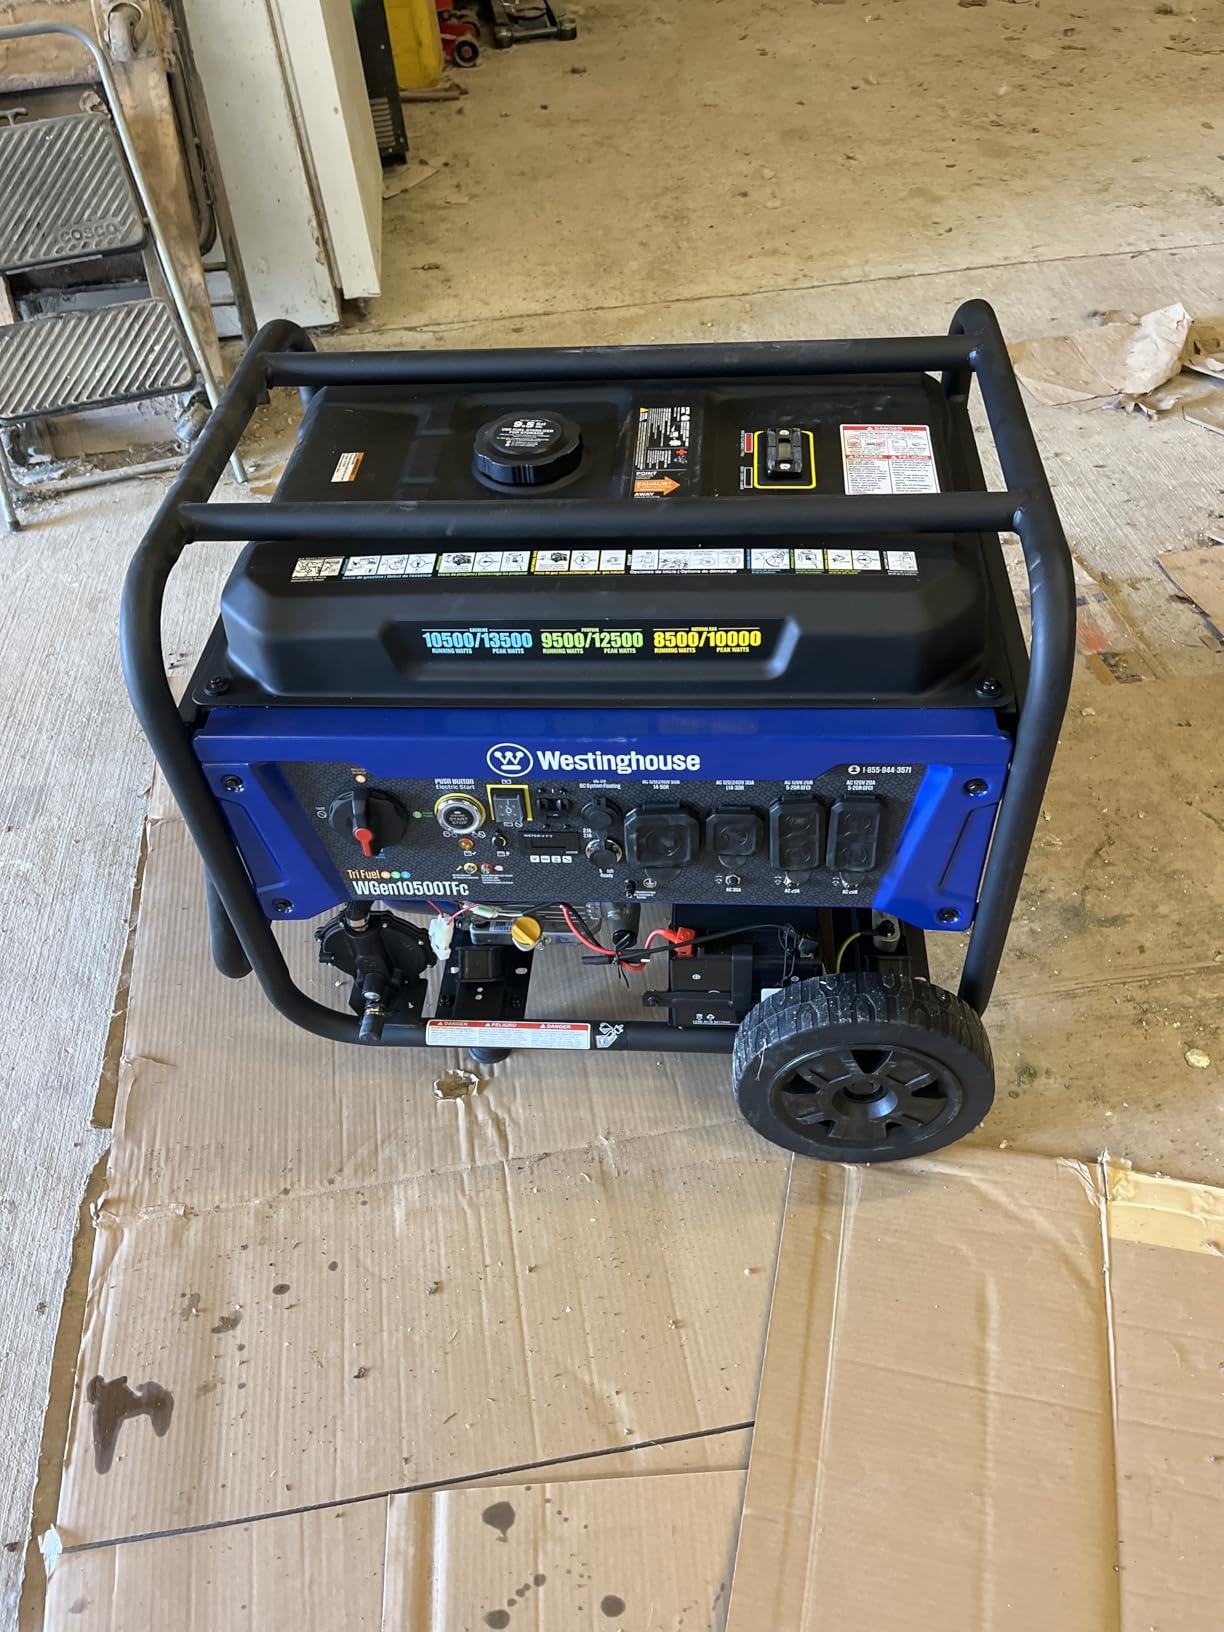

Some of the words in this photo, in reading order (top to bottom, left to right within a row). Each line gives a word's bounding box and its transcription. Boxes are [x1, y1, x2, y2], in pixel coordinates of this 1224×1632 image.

[61, 223, 119, 241] COSCO
[422, 632, 533, 648] 10500/13500
[540, 632, 643, 648] 9500/12500
[653, 631, 762, 648] 8500/10000
[536, 750, 700, 774] Westinghouse
[346, 870, 359, 879] Tri
[360, 870, 380, 879] Fuel
[352, 880, 469, 895] WGen10500TFc
